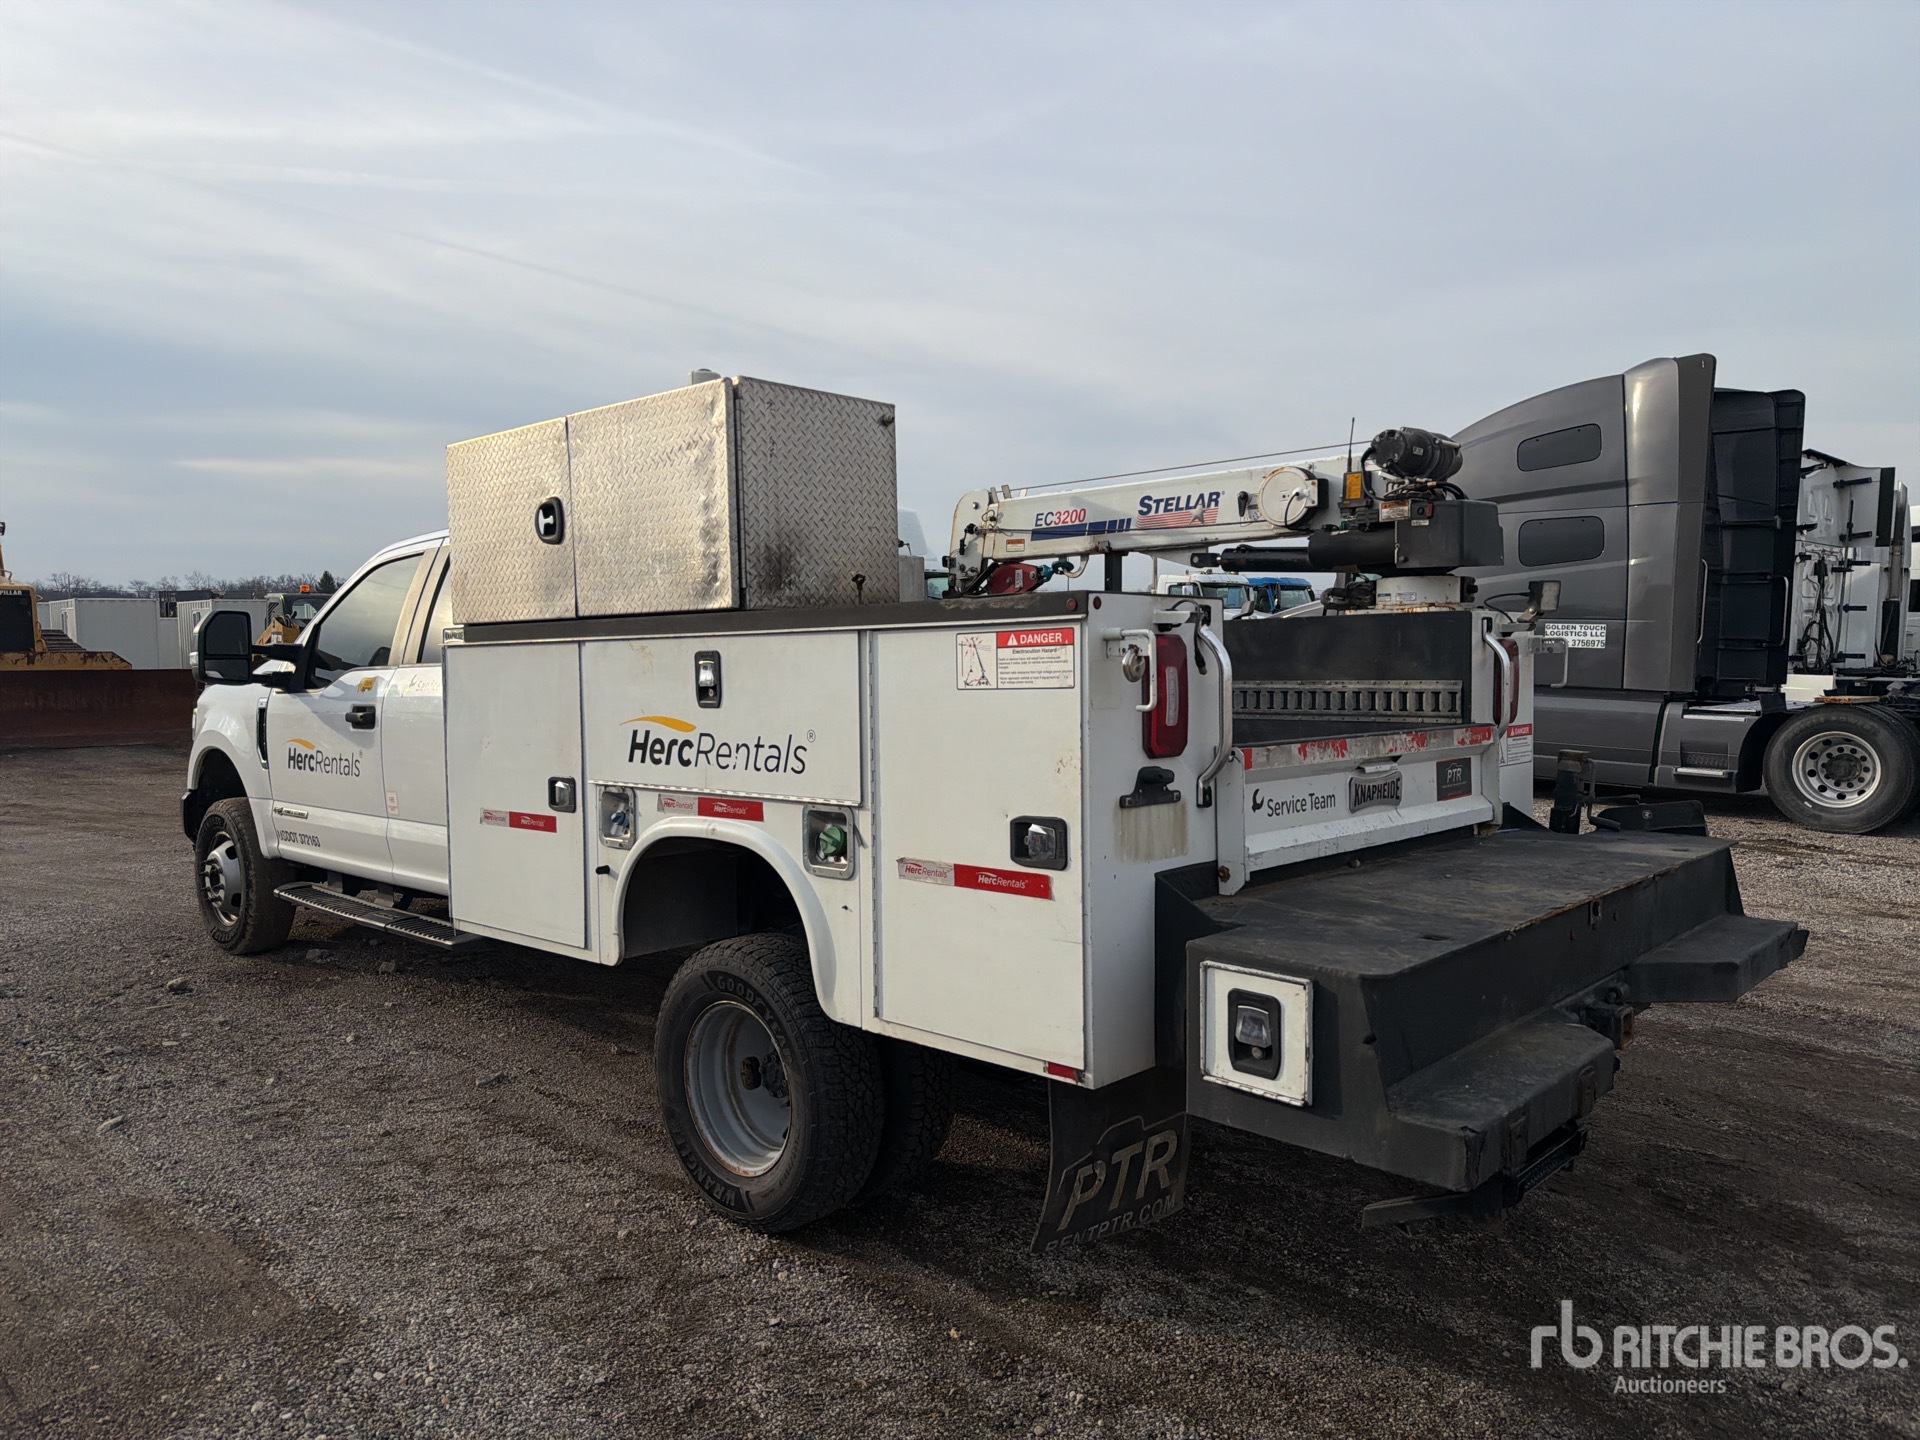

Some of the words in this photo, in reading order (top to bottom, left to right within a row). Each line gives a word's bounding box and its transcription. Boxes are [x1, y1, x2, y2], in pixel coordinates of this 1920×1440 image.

[1138, 491, 1221, 516] STELLAR
[1034, 508, 1087, 527] EC3200
[1020, 632, 1062, 643] DANGER
[1571, 639, 1606, 648] 3756975
[1446, 767, 1462, 784] PTR
[1353, 777, 1401, 807] KNAPHEIDE
[1267, 795, 1307, 817] Service
[1308, 792, 1336, 811] Team
[1056, 1130, 1178, 1232] PTR
